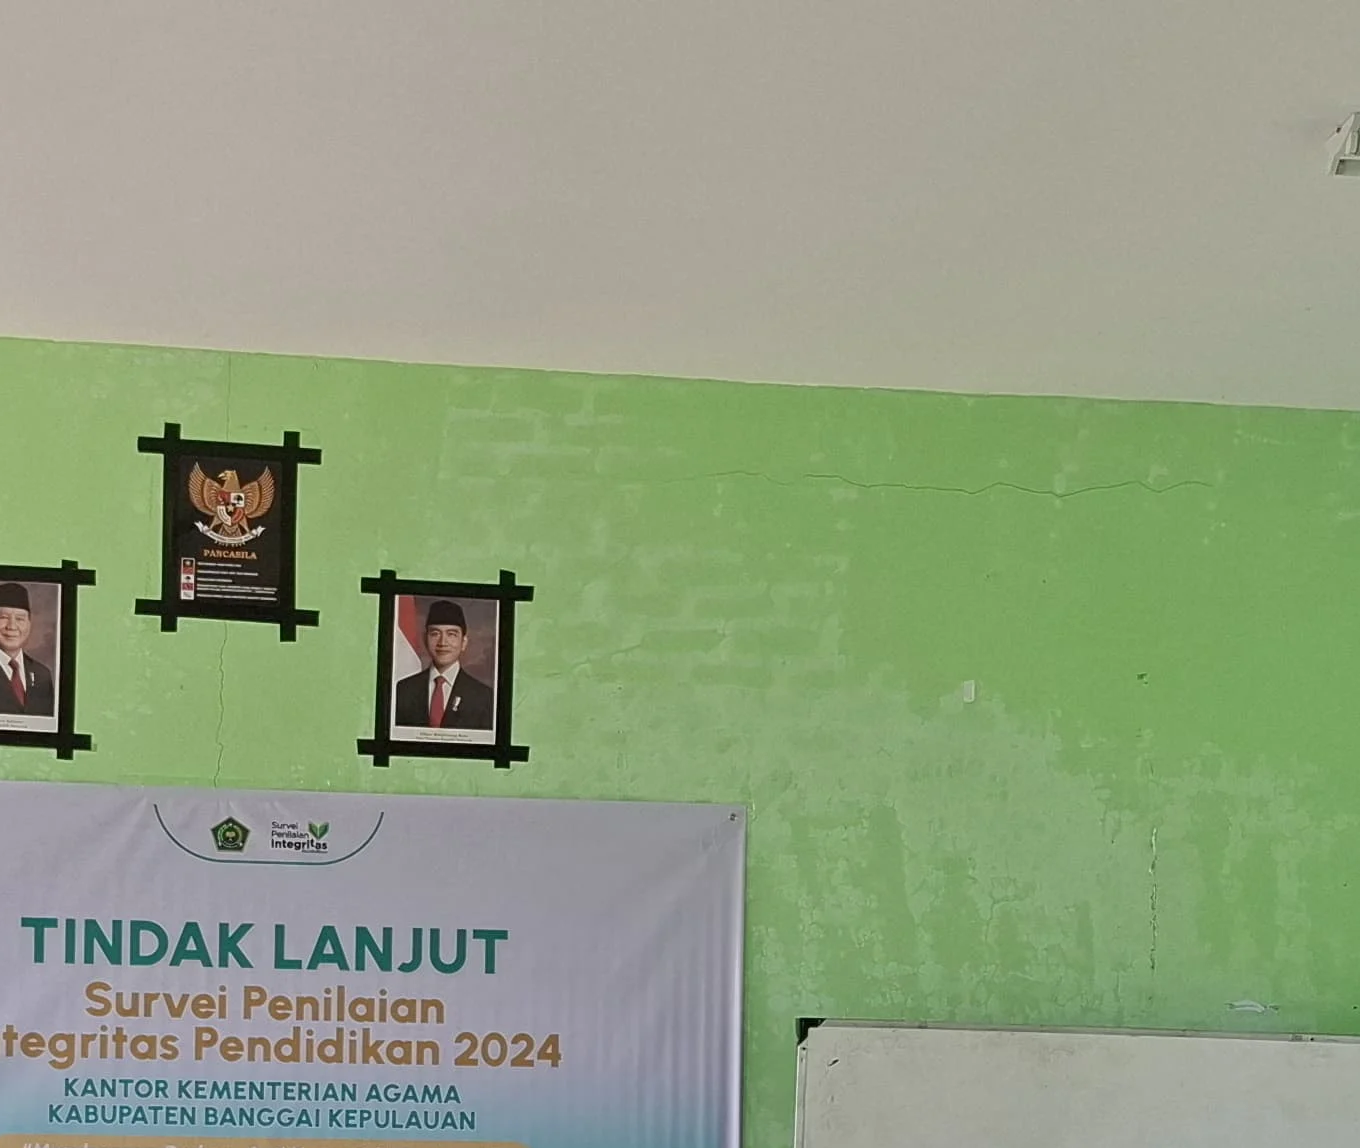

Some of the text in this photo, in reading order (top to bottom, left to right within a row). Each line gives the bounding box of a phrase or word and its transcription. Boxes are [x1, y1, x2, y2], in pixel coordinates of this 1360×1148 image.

[271, 821, 298, 829] Survei
[271, 838, 328, 851] Integritas
[21, 917, 509, 975] TINDAK LANJUT
[85, 981, 445, 1024] Survei Penilaian
[194, 1026, 440, 1066] Pendidikan
[454, 1031, 562, 1068] 2024
[64, 1078, 461, 1104] KANTOR KEMENTERIAN AGAMA
[48, 1104, 476, 1130] KABUPATEN BANGGAI KEPULAUAN
